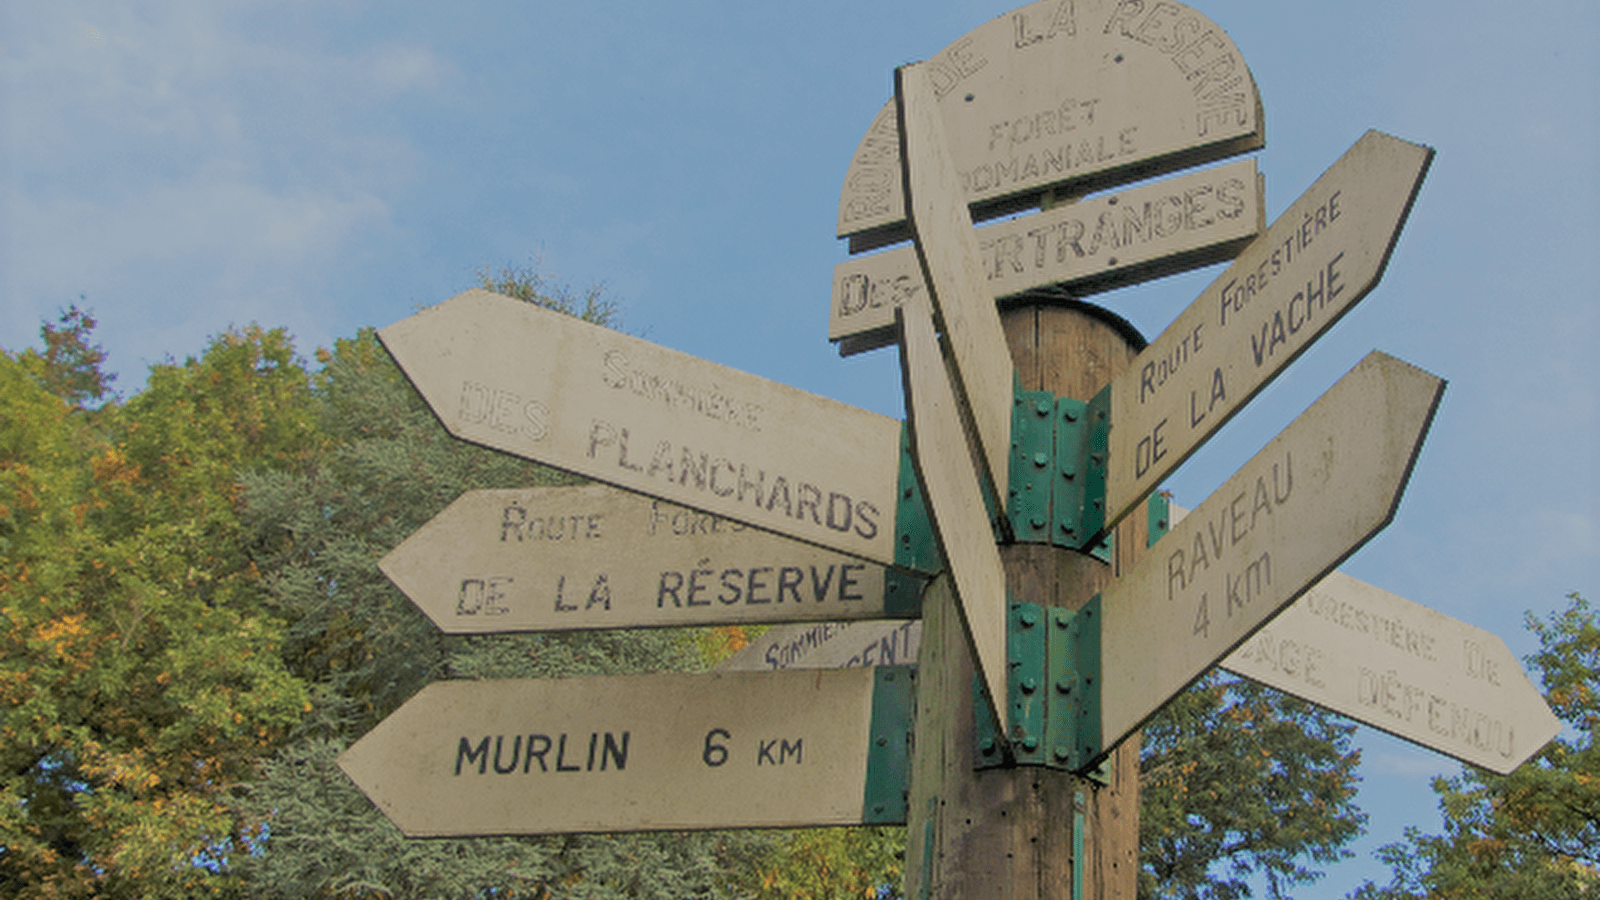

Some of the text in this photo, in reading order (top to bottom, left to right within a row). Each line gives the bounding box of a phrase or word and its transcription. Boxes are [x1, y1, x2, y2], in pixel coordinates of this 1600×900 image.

[928, 38, 988, 101] DE
[1013, 0, 1077, 49] LA
[978, 178, 1246, 280] RTRANGES
[1140, 190, 1342, 404] ROUTE FORESTIÈRE
[1135, 251, 1345, 480] DE LA VACHE
[459, 380, 880, 541] DES PLANCHARDS
[501, 502, 601, 544] ROUTE
[1167, 451, 1293, 601] RAVEAU
[456, 557, 867, 617] DE LA RÉSERVE
[1193, 592, 1211, 639] 4
[1307, 590, 1438, 662] ORESTIÈRE
[454, 728, 804, 776] MURLIN 6 KM
